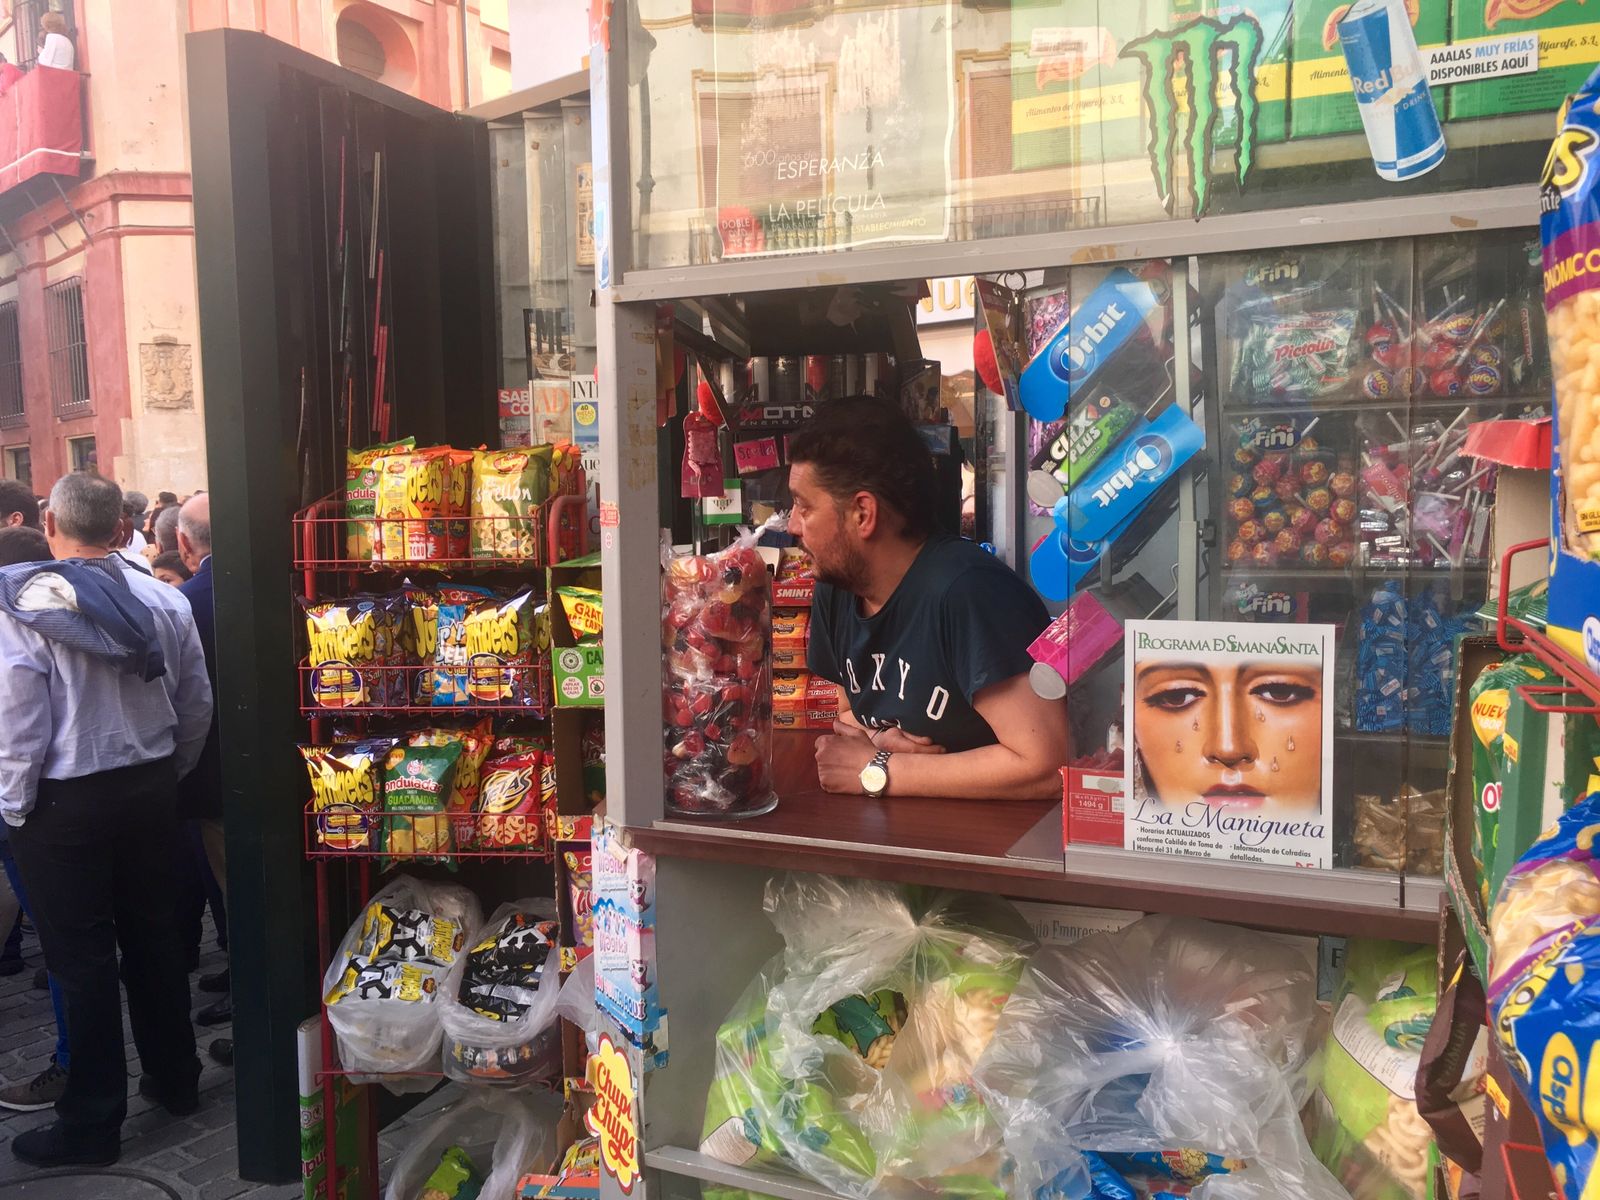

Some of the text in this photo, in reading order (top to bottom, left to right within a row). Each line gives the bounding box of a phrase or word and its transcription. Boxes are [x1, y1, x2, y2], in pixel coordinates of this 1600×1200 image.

[1430, 38, 1534, 64] AAALAS MUY FRÍAS
[1310, 69, 1348, 80] Alimento
[1431, 54, 1528, 80] DISPONIBLES AQUÍ
[1354, 71, 1389, 95] Red
[778, 152, 885, 180] ESPERANZA
[769, 192, 886, 222] LA PELÍCULA
[1255, 261, 1299, 283] Fini
[1061, 301, 1127, 371] Orbit
[1068, 426, 1101, 463] PLUS
[1254, 426, 1295, 448] Fini
[1091, 445, 1161, 508] Orbit
[776, 588, 806, 598] SMINT
[1252, 596, 1290, 614] Fini
[1138, 632, 1213, 651] PROGRAMA
[809, 711, 838, 719] Trident
[1473, 703, 1506, 719] NUEV
[1079, 800, 1096, 808] 1494
[1130, 797, 1173, 825] La
[1136, 836, 1163, 844] conforme
[1186, 839, 1196, 847] de
[1198, 841, 1213, 849] Toma
[1140, 826, 1210, 839] Horarios ACTUALIZADOS
[1136, 844, 1153, 852] Horas
[1174, 847, 1182, 855] de
[1183, 848, 1202, 856] Marzo
[1233, 843, 1270, 854] Información
[1272, 847, 1280, 855] de
